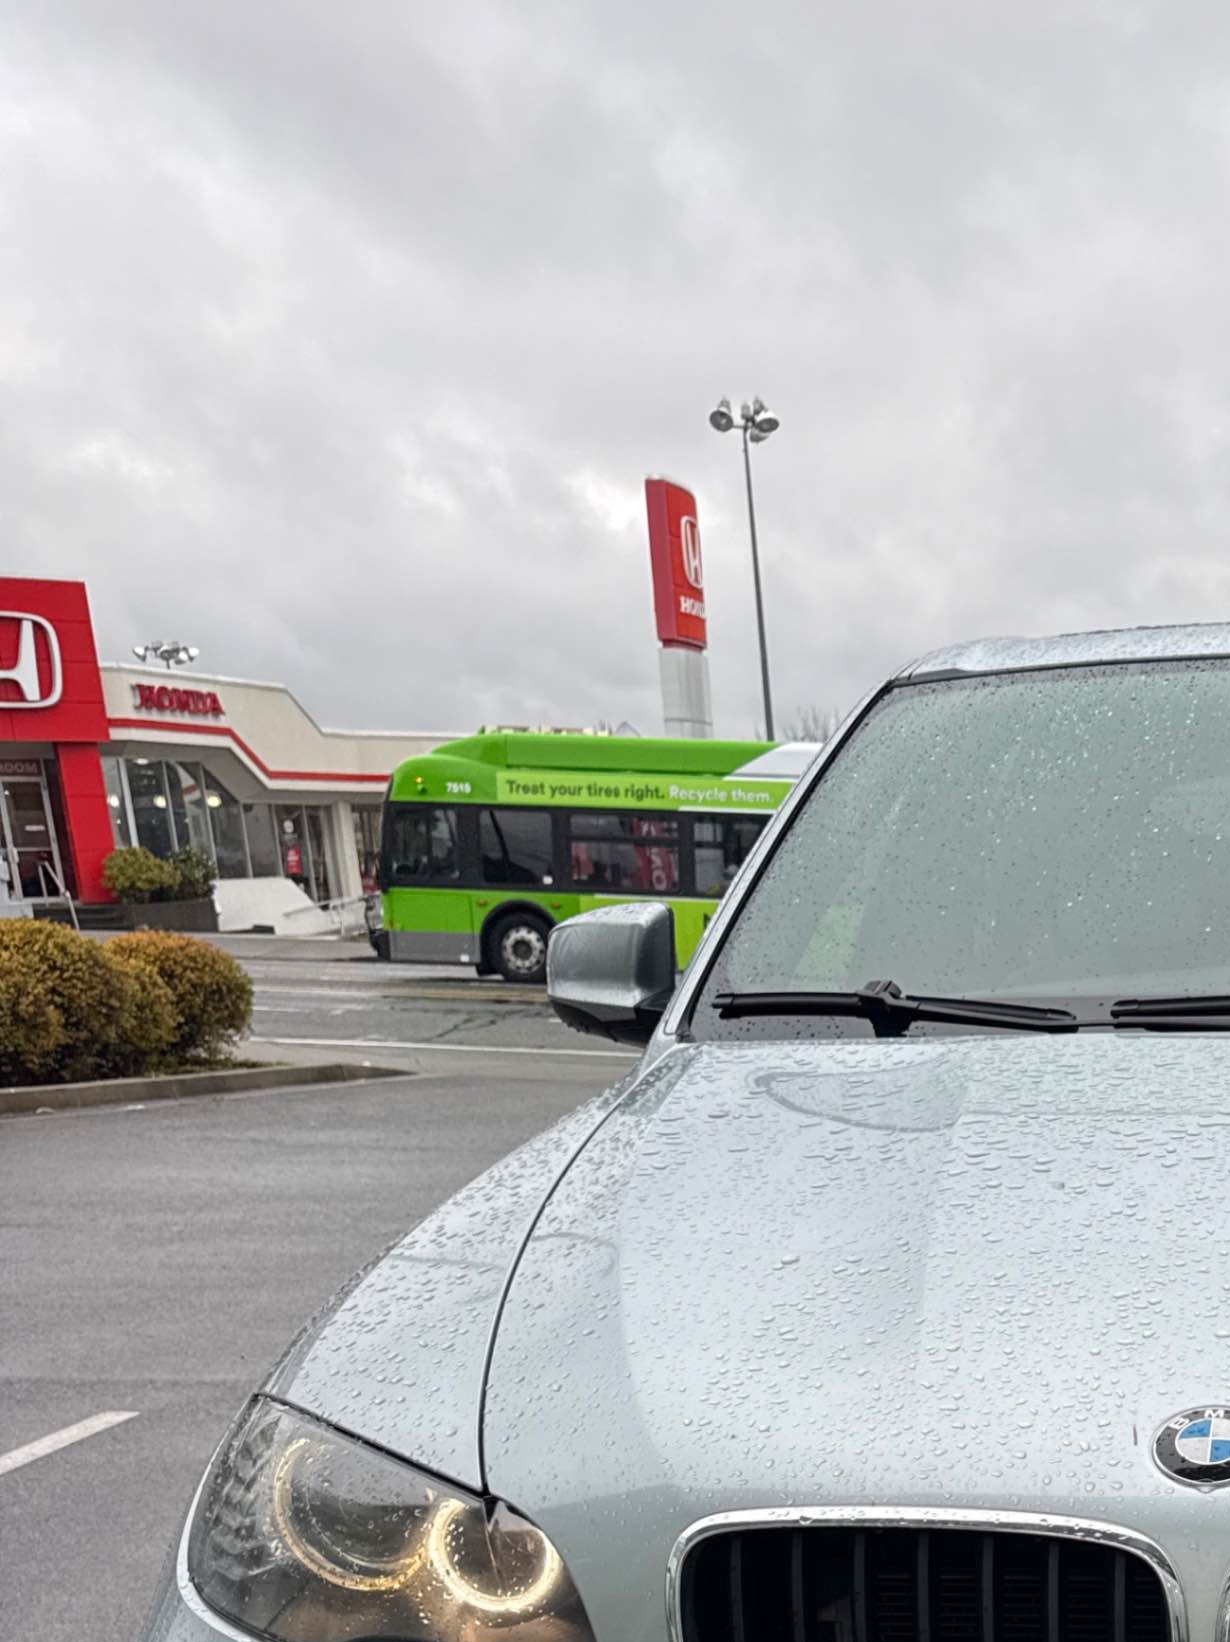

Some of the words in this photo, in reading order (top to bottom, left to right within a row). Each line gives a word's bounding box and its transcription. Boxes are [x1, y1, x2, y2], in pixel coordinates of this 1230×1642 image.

[132, 683, 225, 718] HONDA
[506, 780, 545, 795] Treat
[550, 783, 583, 798] your
[587, 783, 620, 798] tires
[624, 784, 665, 802] right.
[669, 785, 727, 803] Recycle
